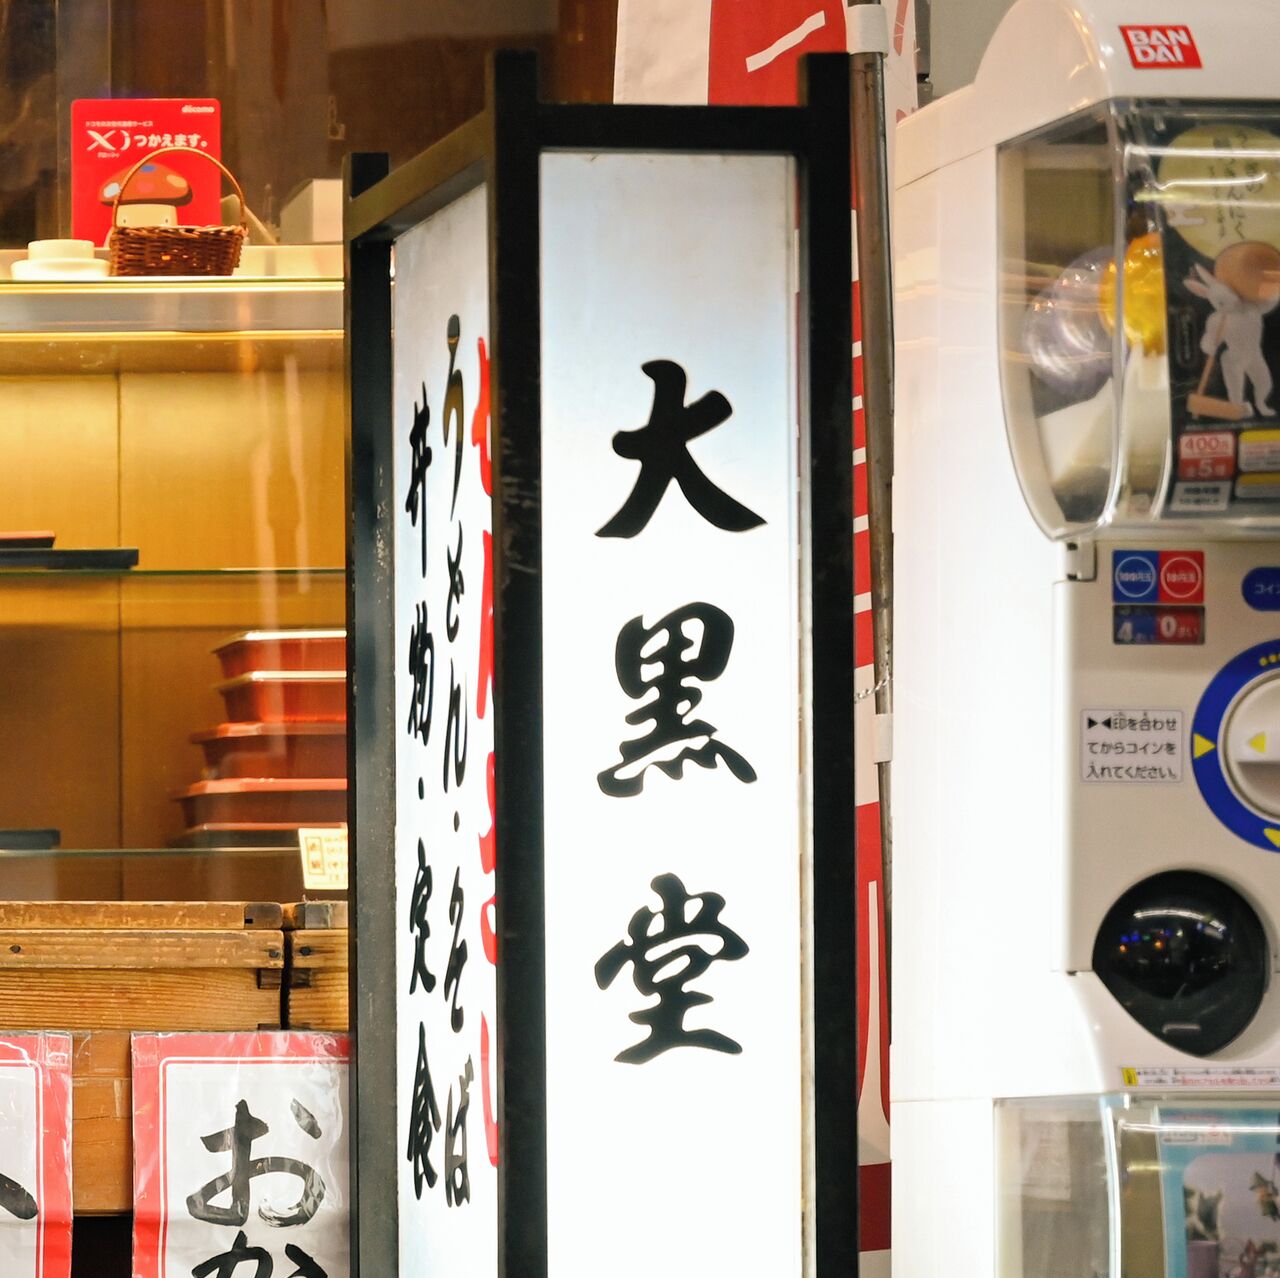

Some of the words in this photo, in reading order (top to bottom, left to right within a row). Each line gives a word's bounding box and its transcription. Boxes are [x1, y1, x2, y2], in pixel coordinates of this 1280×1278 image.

[594, 359, 768, 1064] 大黒堂
[1087, 741, 1177, 755] てからコインを
